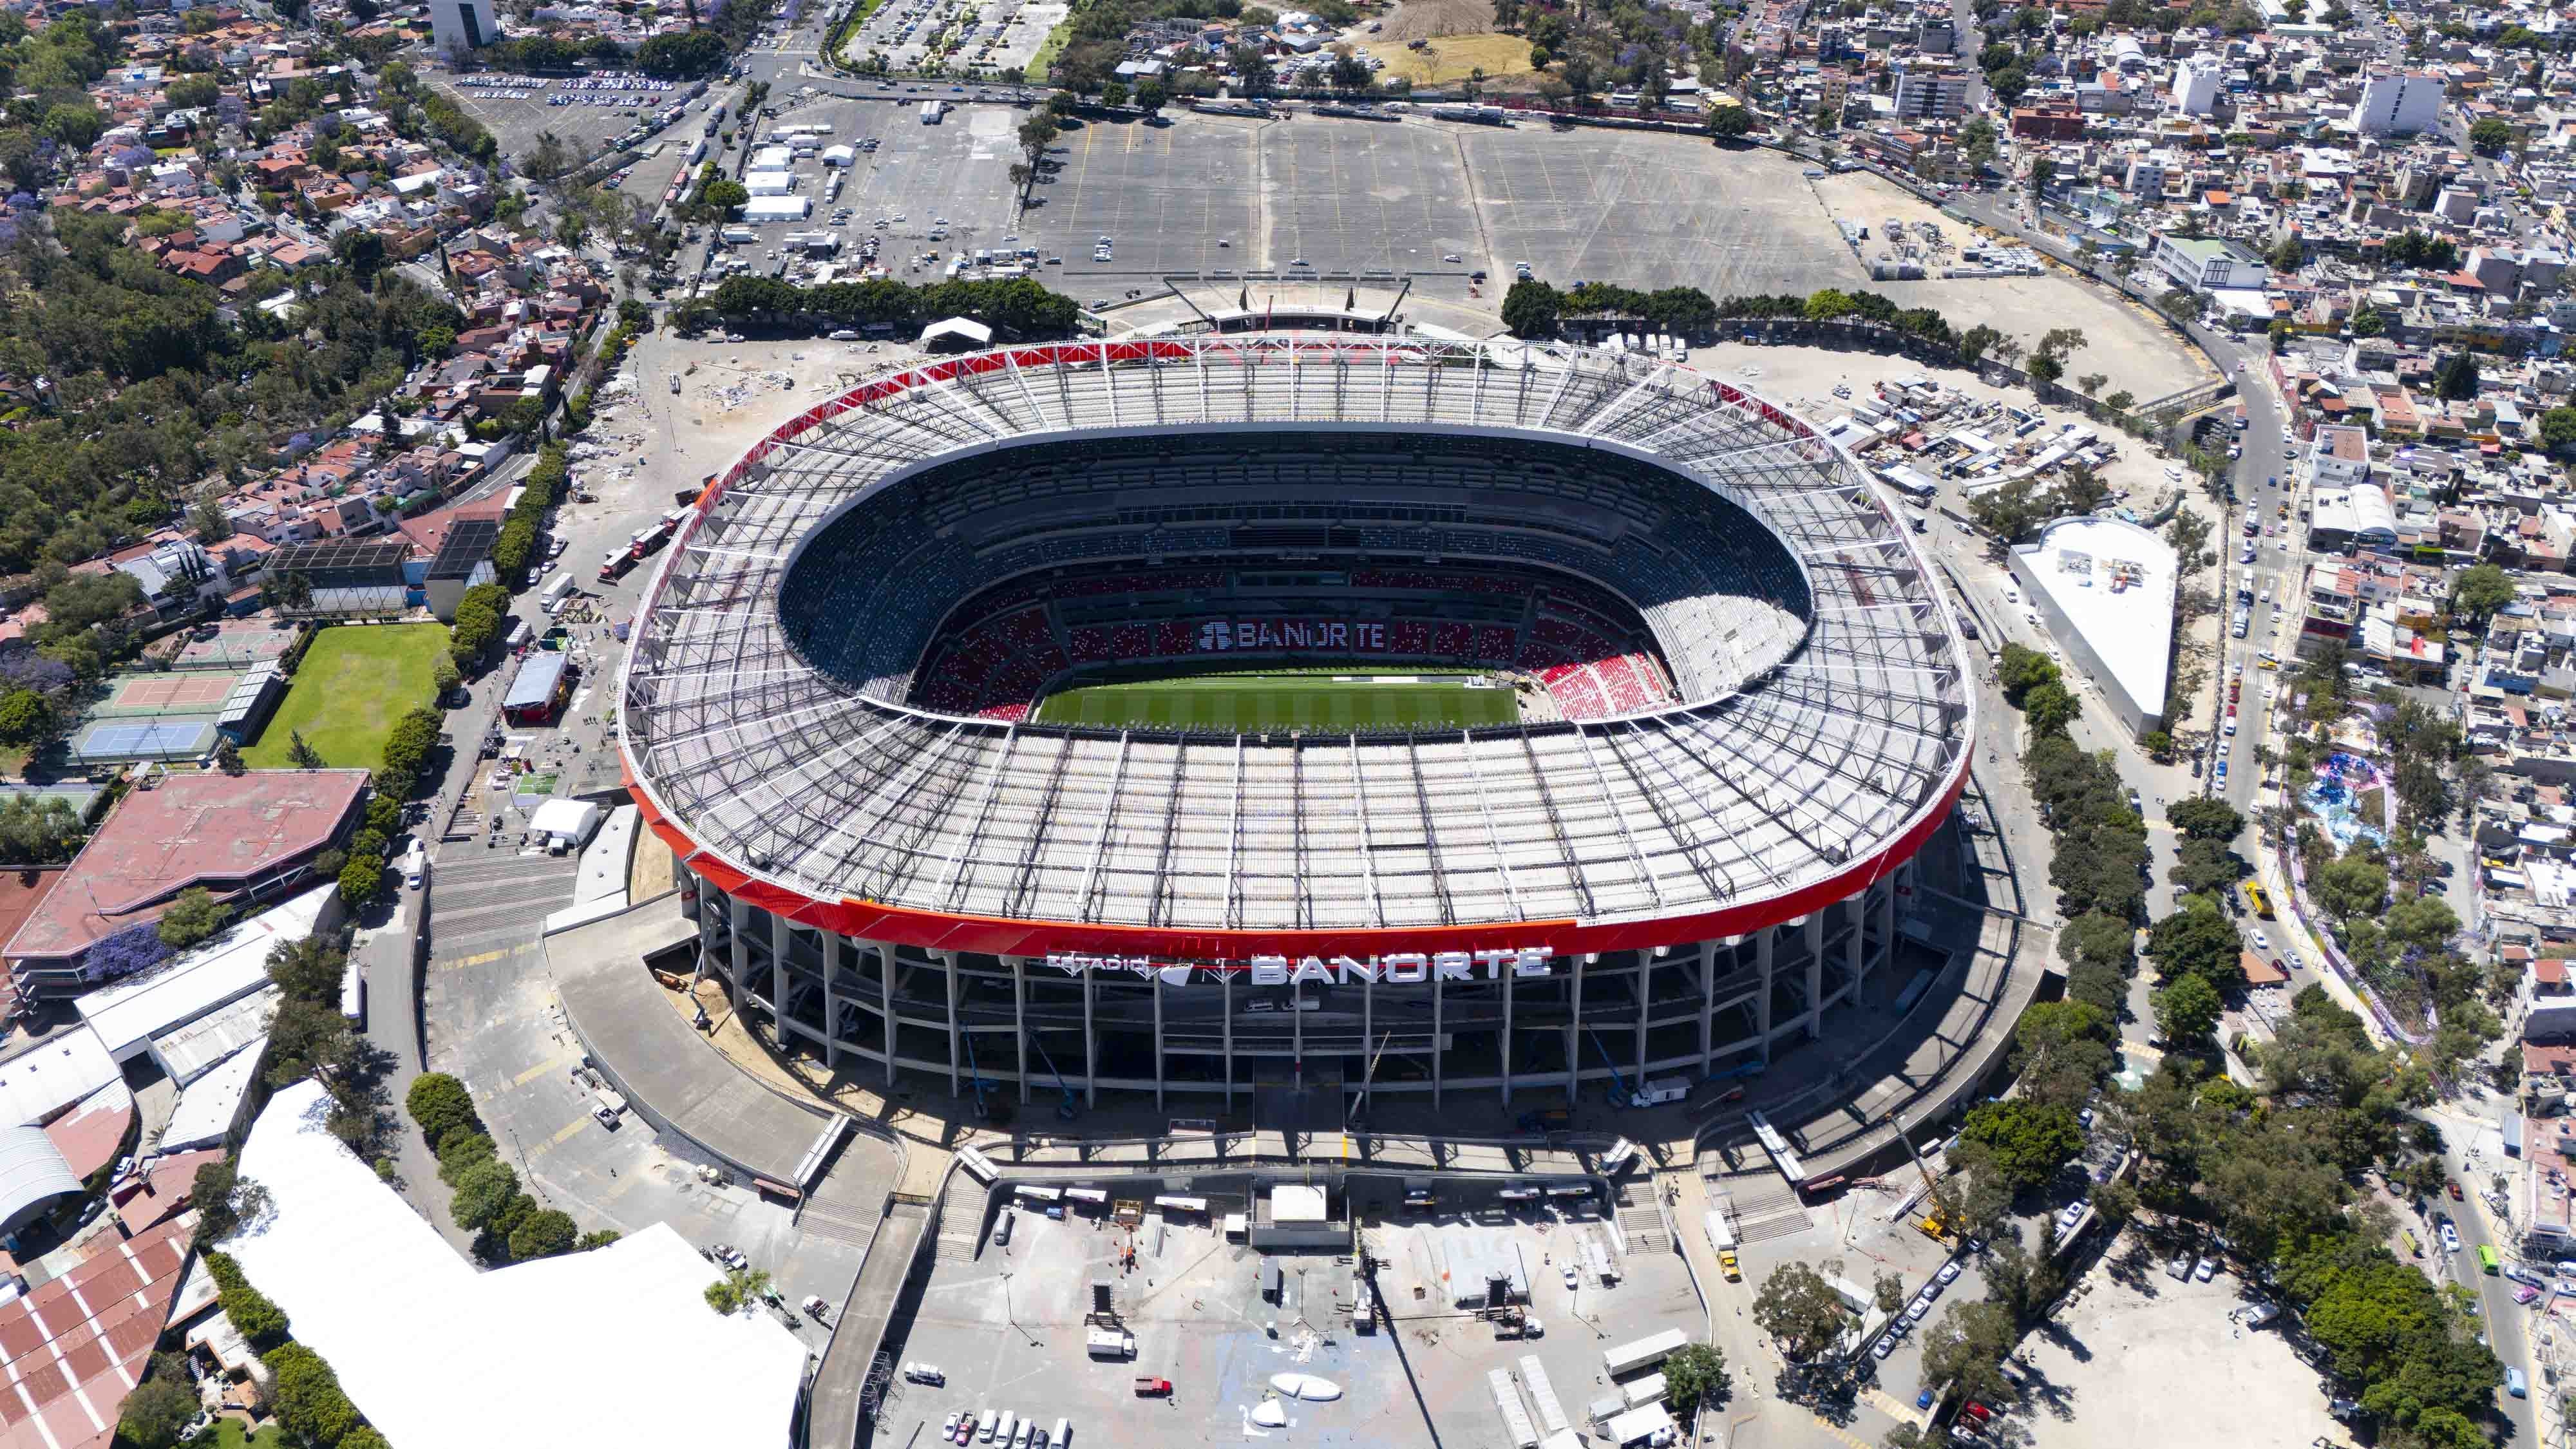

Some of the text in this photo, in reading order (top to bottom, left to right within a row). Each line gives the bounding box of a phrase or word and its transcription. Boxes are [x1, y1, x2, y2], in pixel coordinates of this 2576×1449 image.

[1236, 622, 1384, 648] BANORTE
[1046, 947, 1553, 985] ESTADIO BANORTE
